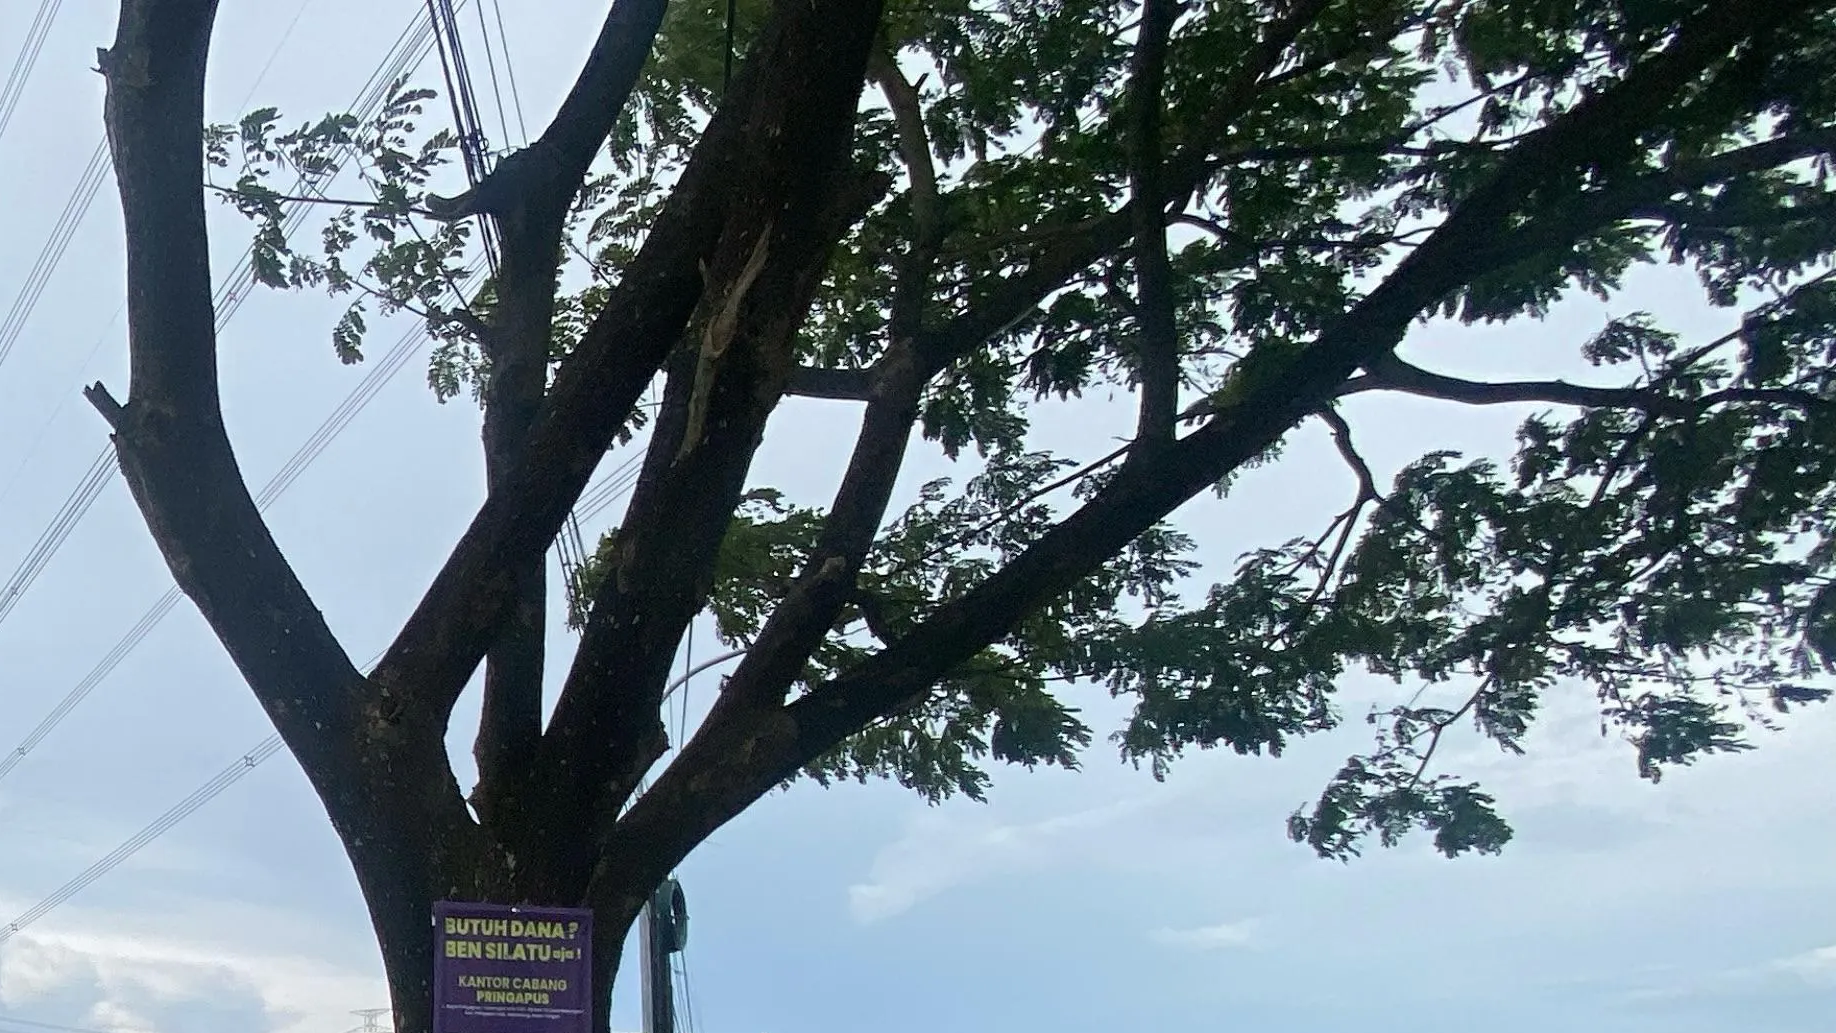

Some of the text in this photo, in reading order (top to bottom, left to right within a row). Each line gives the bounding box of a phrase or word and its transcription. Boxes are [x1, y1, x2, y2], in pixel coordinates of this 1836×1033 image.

[445, 917, 507, 936] BUTUH
[510, 920, 565, 939] DANA
[445, 940, 482, 958] BEN
[485, 942, 551, 961] SILATU
[553, 947, 574, 962] aja
[458, 976, 567, 991] KANTOR CABANG
[476, 990, 550, 1005] PRINGAPUS
